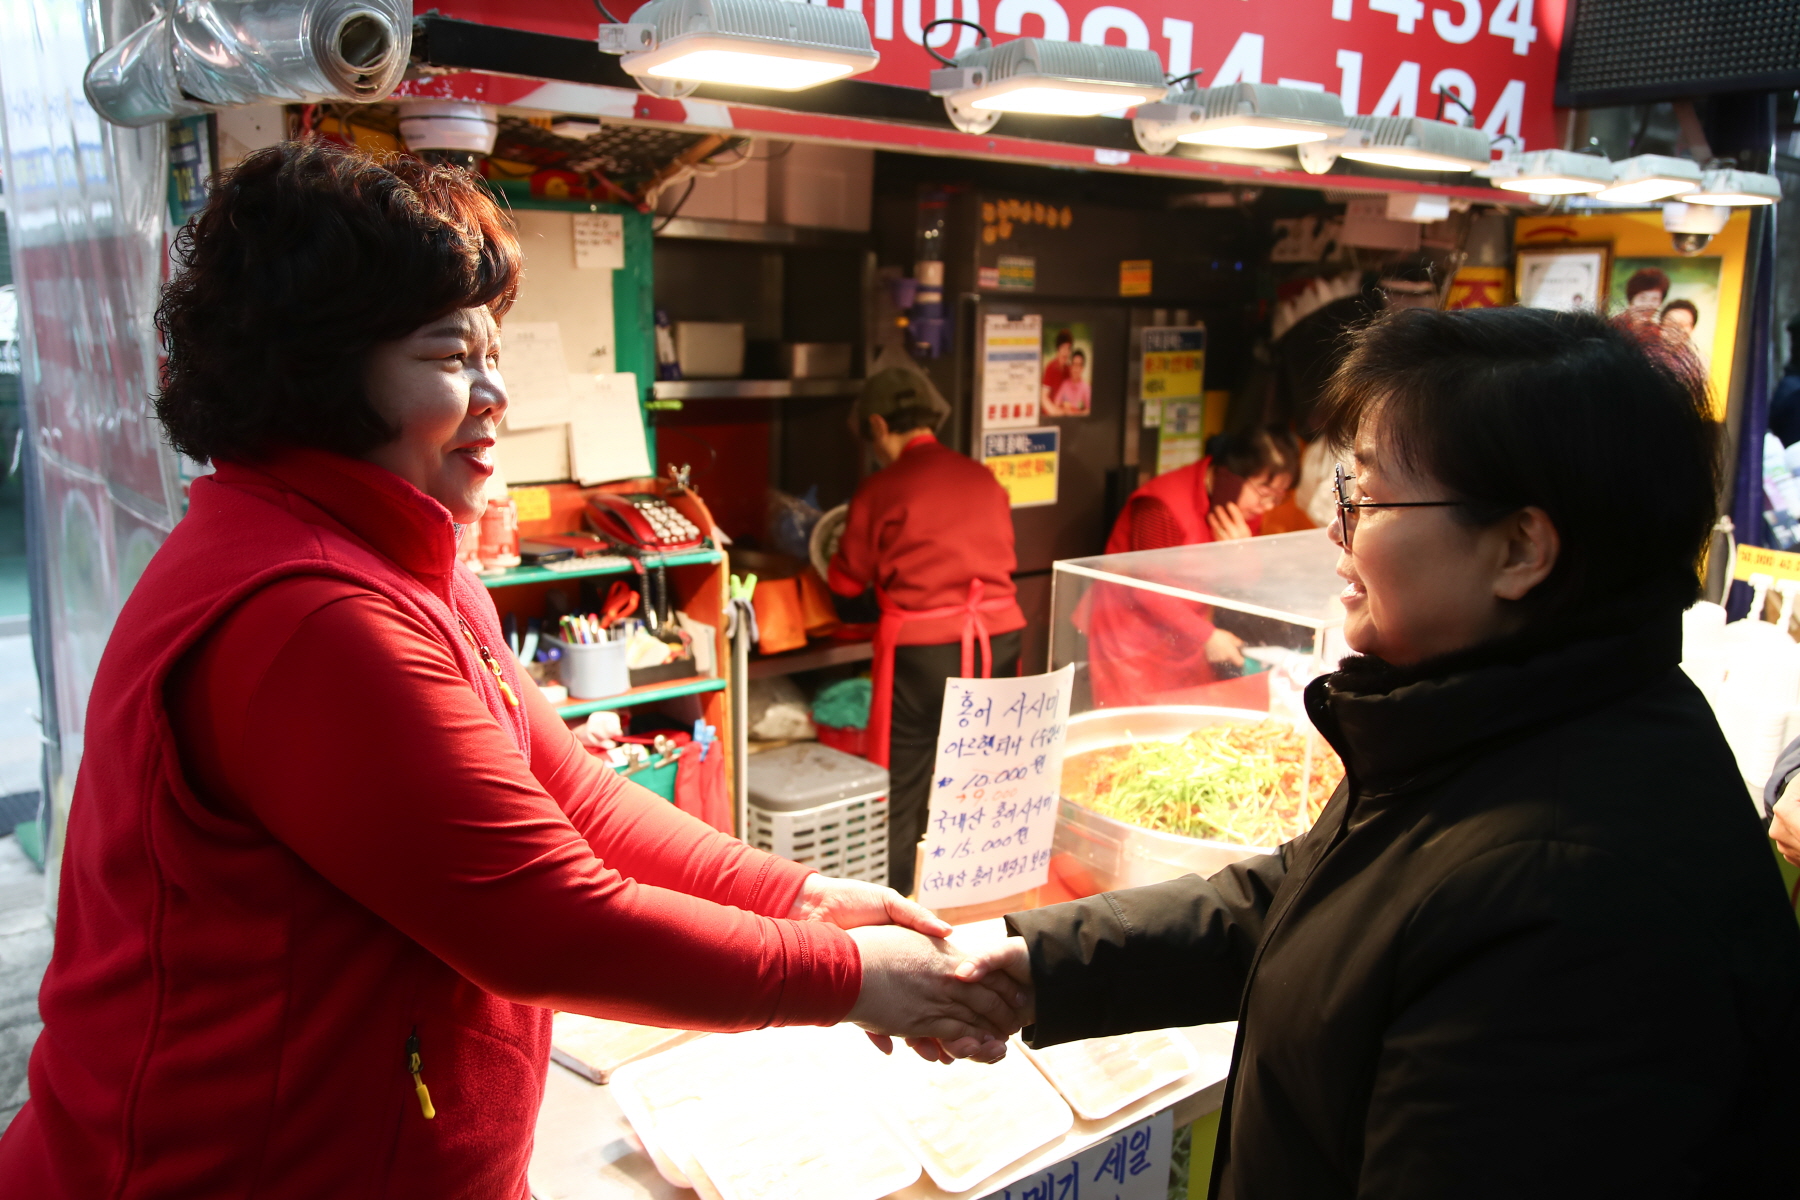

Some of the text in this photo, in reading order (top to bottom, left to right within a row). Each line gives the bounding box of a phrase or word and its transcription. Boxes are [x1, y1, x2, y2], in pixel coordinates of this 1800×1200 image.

[1332, 0, 1537, 56] 434
[957, 688, 1060, 728] 홍어 사시미
[1004, 1126, 1152, 1200] 메기 세일
